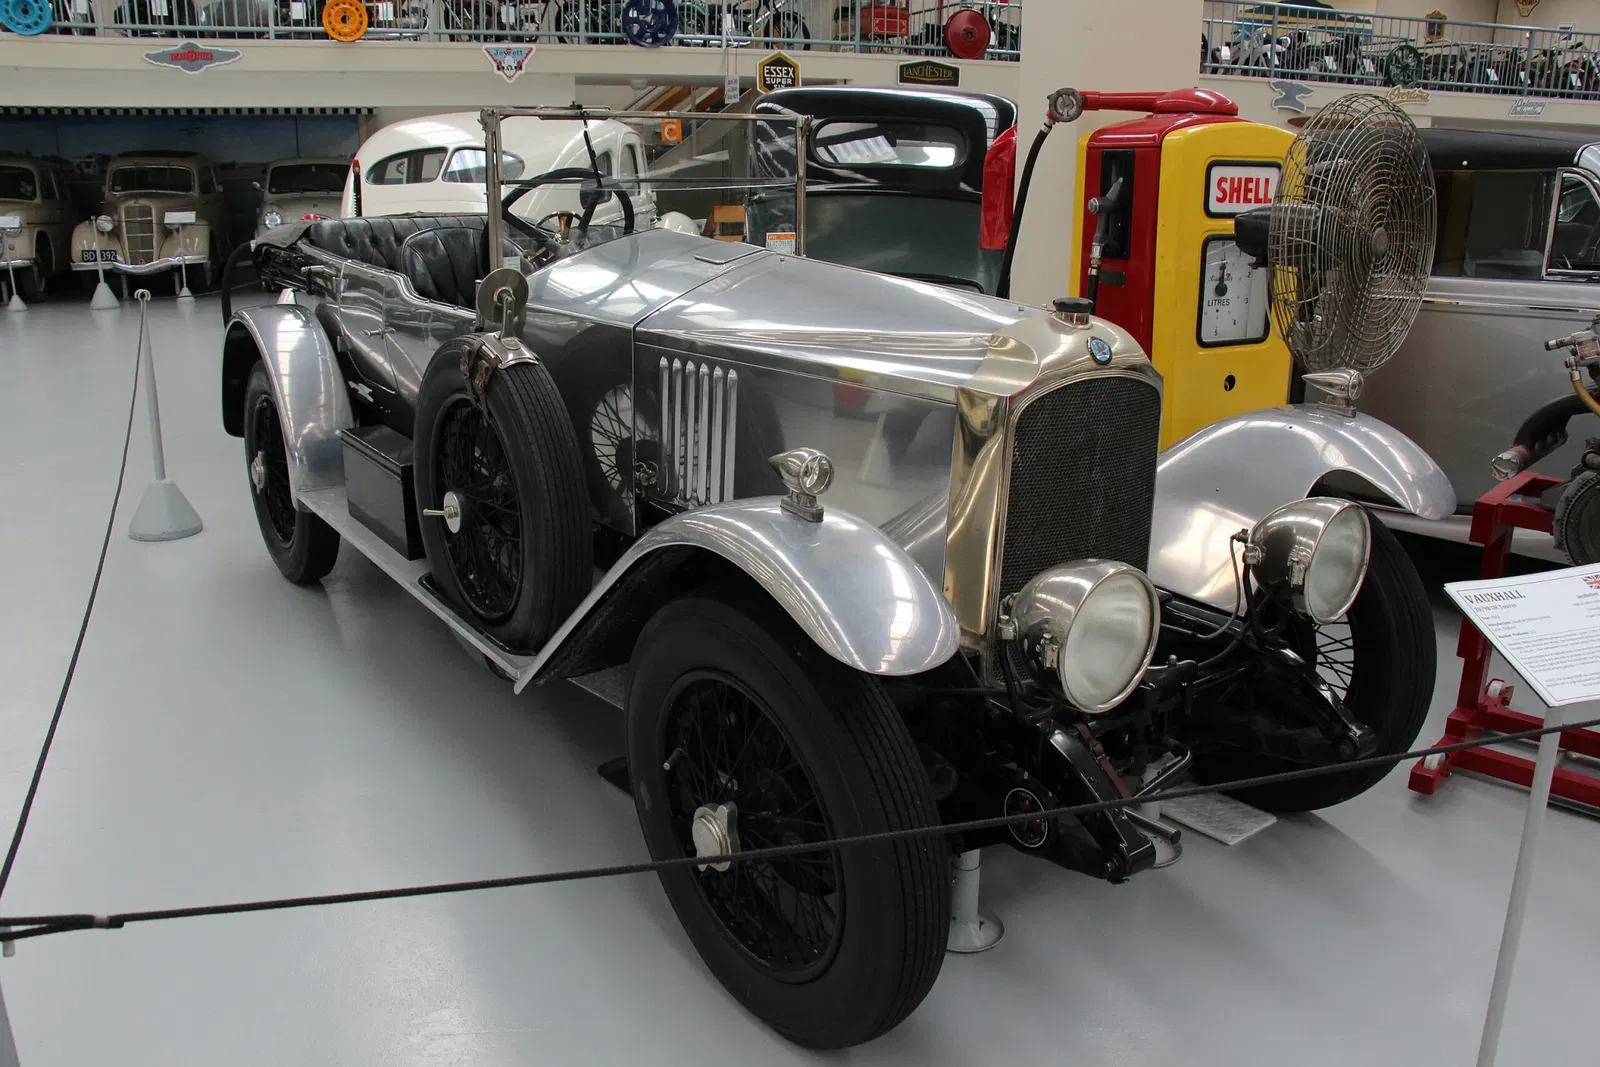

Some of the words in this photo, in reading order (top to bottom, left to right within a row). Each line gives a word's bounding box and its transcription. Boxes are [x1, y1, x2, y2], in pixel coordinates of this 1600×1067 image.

[494, 48, 523, 56] Jowett
[764, 66, 794, 78] ESSEX
[903, 65, 953, 78] LANCHESTER
[1215, 176, 1272, 204] SHELL
[83, 251, 96, 261] BD
[101, 251, 116, 261] 392
[1207, 298, 1230, 307] LITRES
[1464, 589, 1526, 604] VAUXHALL
